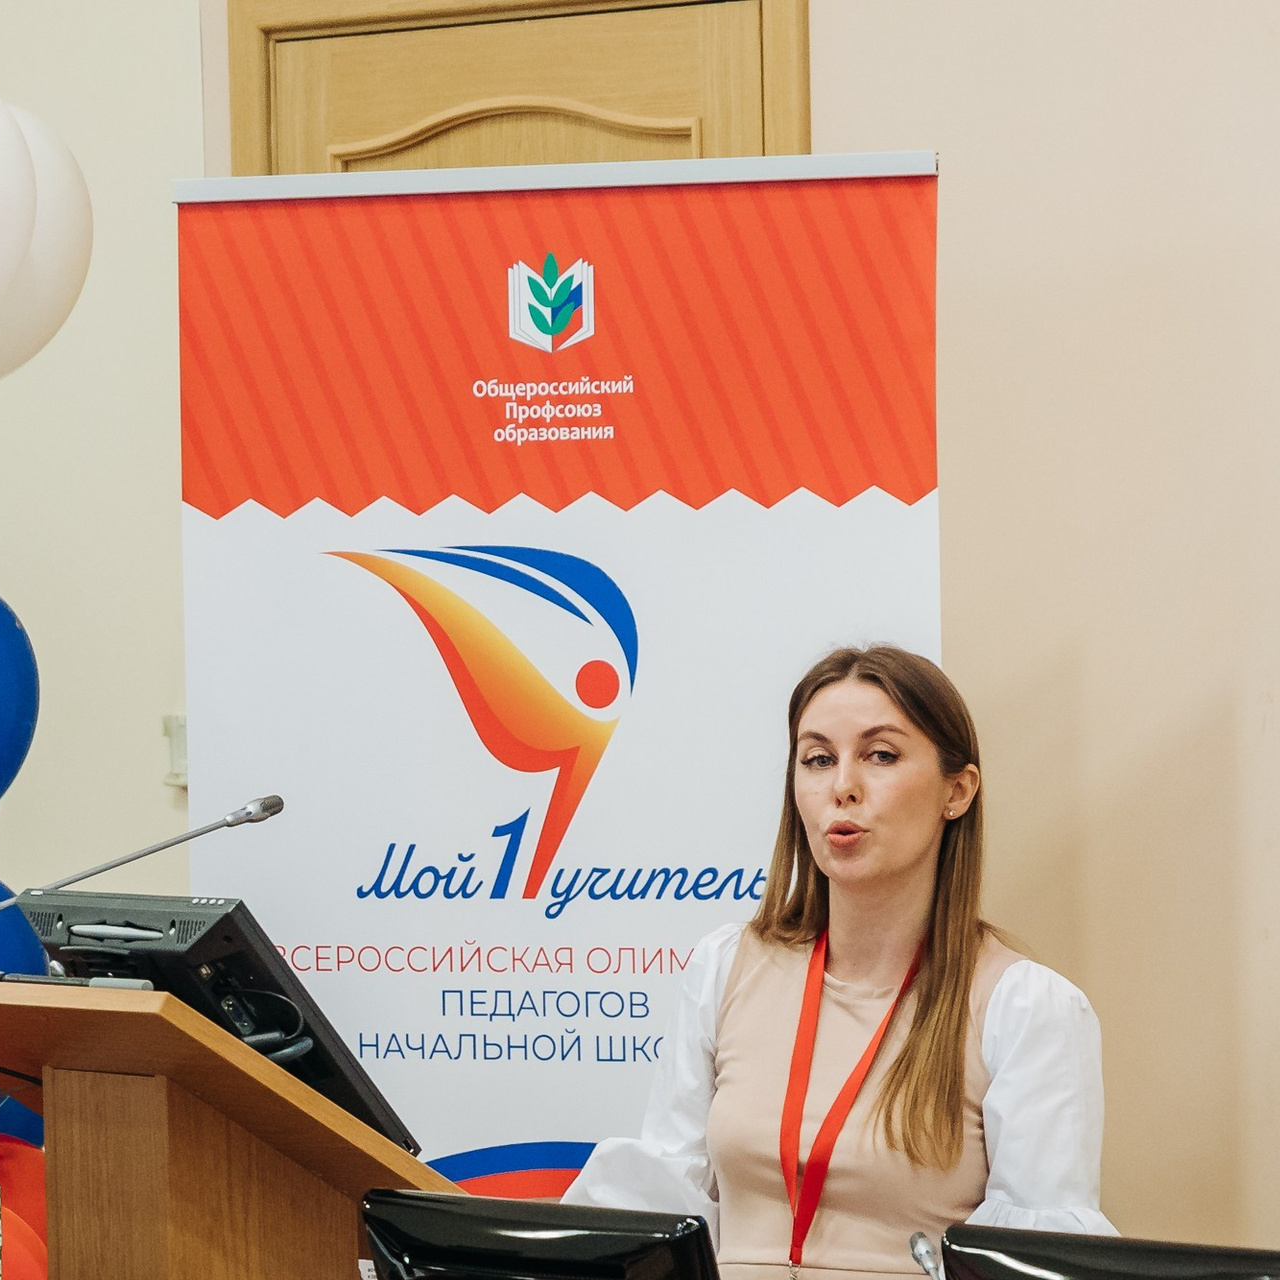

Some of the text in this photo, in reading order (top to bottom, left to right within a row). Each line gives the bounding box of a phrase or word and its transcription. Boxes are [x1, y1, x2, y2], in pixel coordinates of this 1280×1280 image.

[472, 375, 634, 400] Общероссийский
[505, 400, 602, 423] Профсоюз
[493, 424, 614, 446] образования
[357, 843, 483, 899] Мой
[544, 867, 767, 920] учитель
[442, 990, 650, 1022] ПЕДАГОГОВ
[359, 1029, 582, 1062] НАЧАЛЬНОЙ
